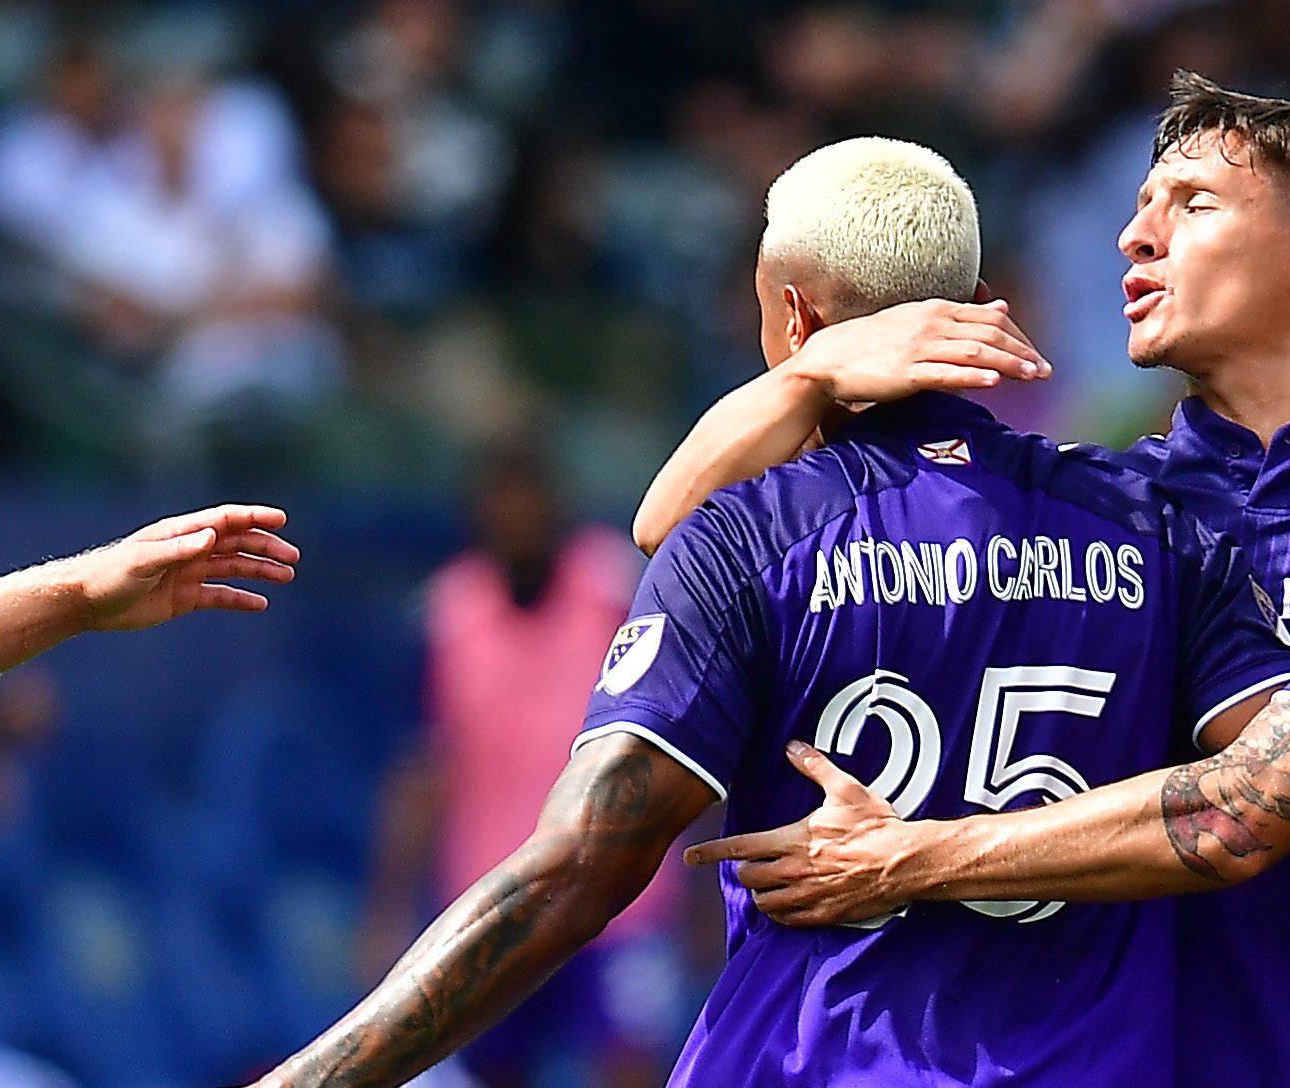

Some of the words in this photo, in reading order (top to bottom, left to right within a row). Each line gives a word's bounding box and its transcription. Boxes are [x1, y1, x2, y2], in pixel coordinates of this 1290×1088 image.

[810, 538, 978, 613] ANTONIO
[987, 534, 1144, 609] CARLOS
[814, 668, 1116, 930] 25
